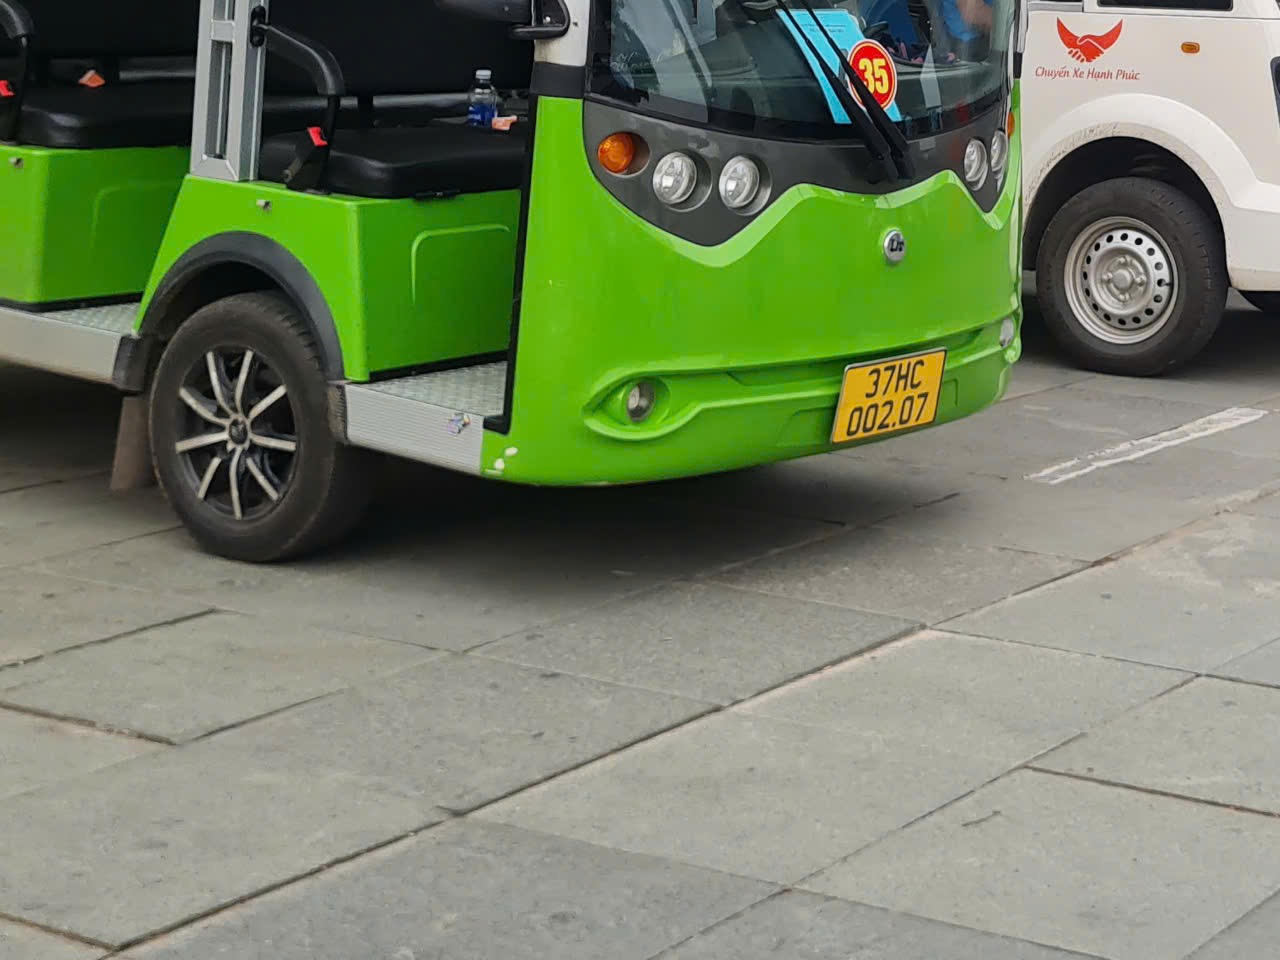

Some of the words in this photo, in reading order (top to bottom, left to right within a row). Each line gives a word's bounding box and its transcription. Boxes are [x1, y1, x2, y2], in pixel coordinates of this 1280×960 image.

[858, 58, 889, 95] 35
[1035, 66, 1070, 80] Chuyến
[1072, 66, 1085, 77] Xe
[1086, 68, 1113, 82] Hạnh
[1115, 69, 1141, 81] Phúc
[865, 359, 924, 399] 37HC
[846, 392, 929, 437] 002.07
